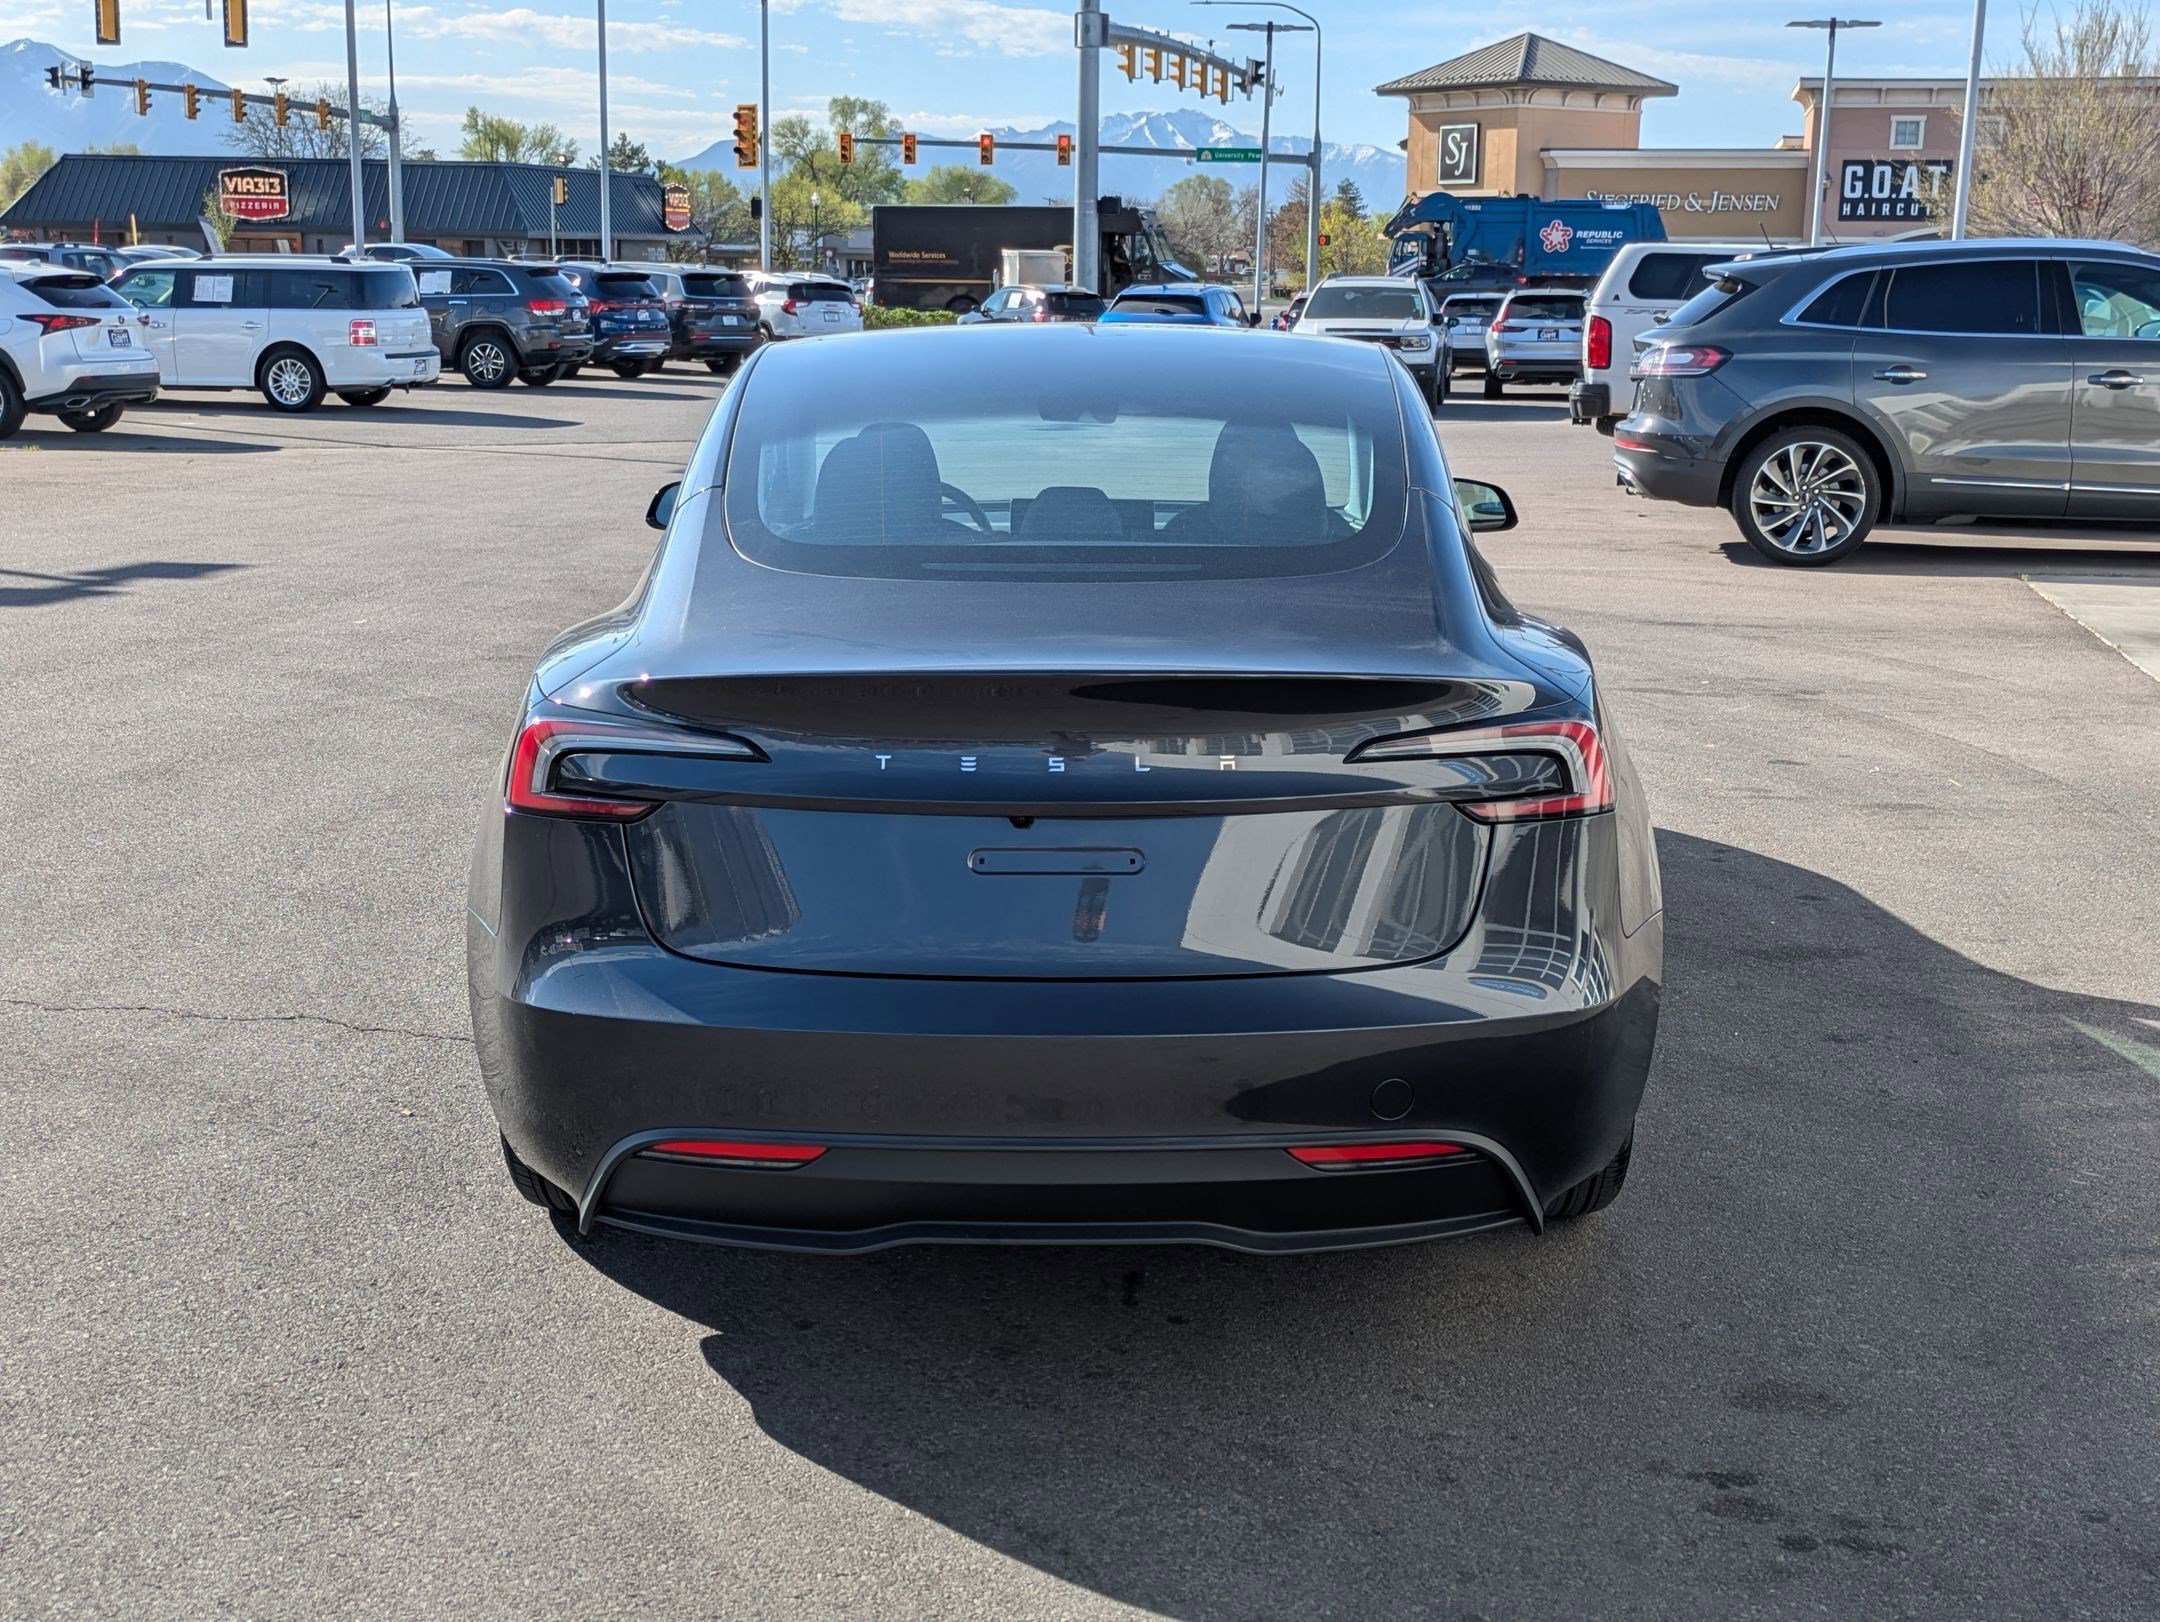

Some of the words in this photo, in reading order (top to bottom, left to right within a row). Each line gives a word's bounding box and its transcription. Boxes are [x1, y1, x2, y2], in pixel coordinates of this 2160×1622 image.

[1445, 132, 1469, 176] SJ
[223, 177, 281, 193] VIA313
[1684, 192, 1704, 212] &
[1576, 230, 1623, 239] REPUBLIC
[888, 250, 920, 259] Worldwide
[921, 250, 946, 259] Services
[875, 755, 1236, 772] TESLA
